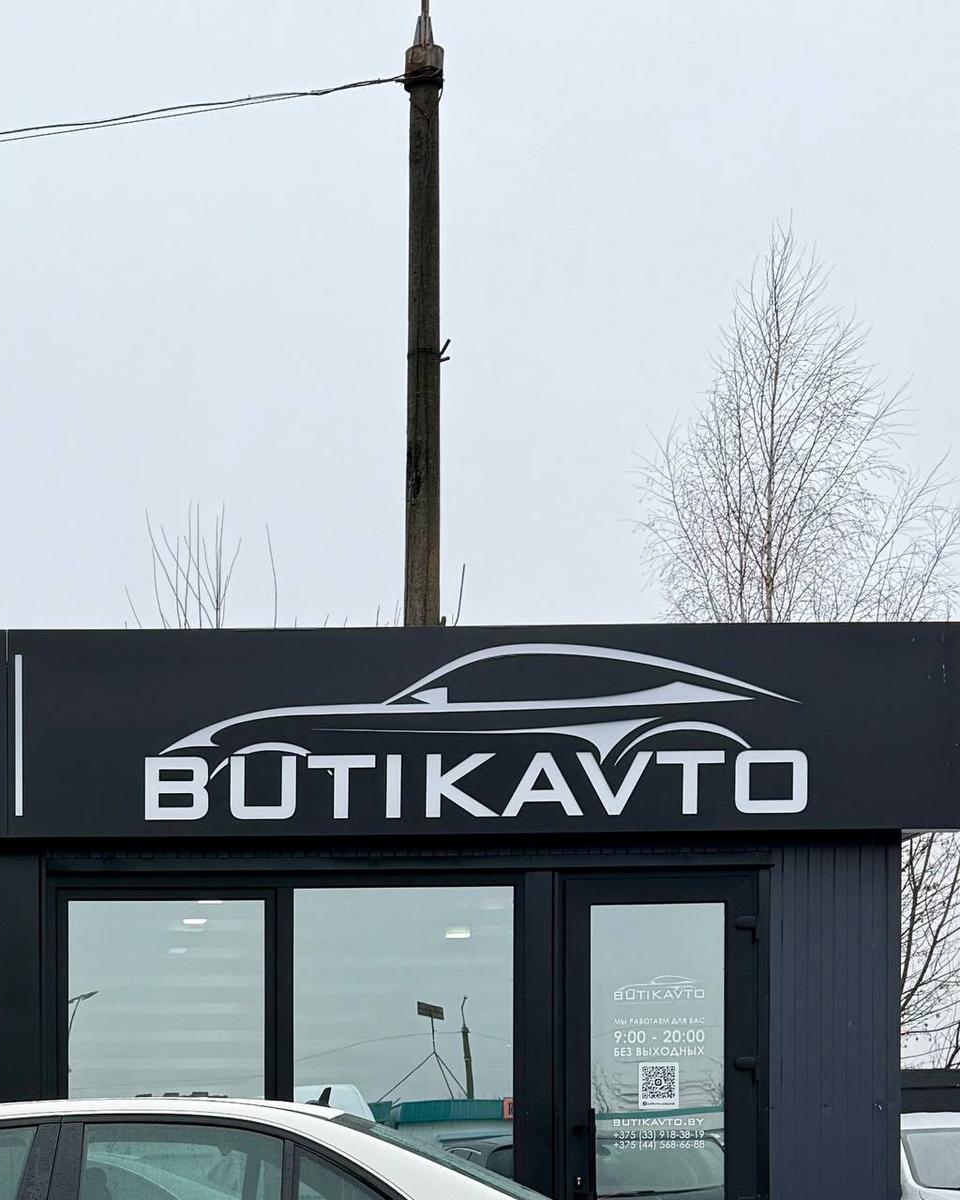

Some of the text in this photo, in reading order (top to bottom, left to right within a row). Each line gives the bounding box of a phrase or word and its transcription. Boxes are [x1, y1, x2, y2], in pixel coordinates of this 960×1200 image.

[144, 749, 808, 821] BUTIKAVTO
[613, 989, 705, 1001] BUTIKAVTO
[629, 1017, 669, 1025] РАБОТАЕМ
[670, 1017, 687, 1025] ДЛЯ
[614, 1030, 646, 1044] 9:00
[662, 1030, 705, 1043] 20:00
[614, 1046, 705, 1057] БЕЗ ВЫХОДНЫХ
[613, 1118, 705, 1127] BUTIKAVTO.BY
[614, 1130, 705, 1141] +375 (33) 918-38-19
[614, 1140, 705, 1150] +375 (44) 568-66-88
